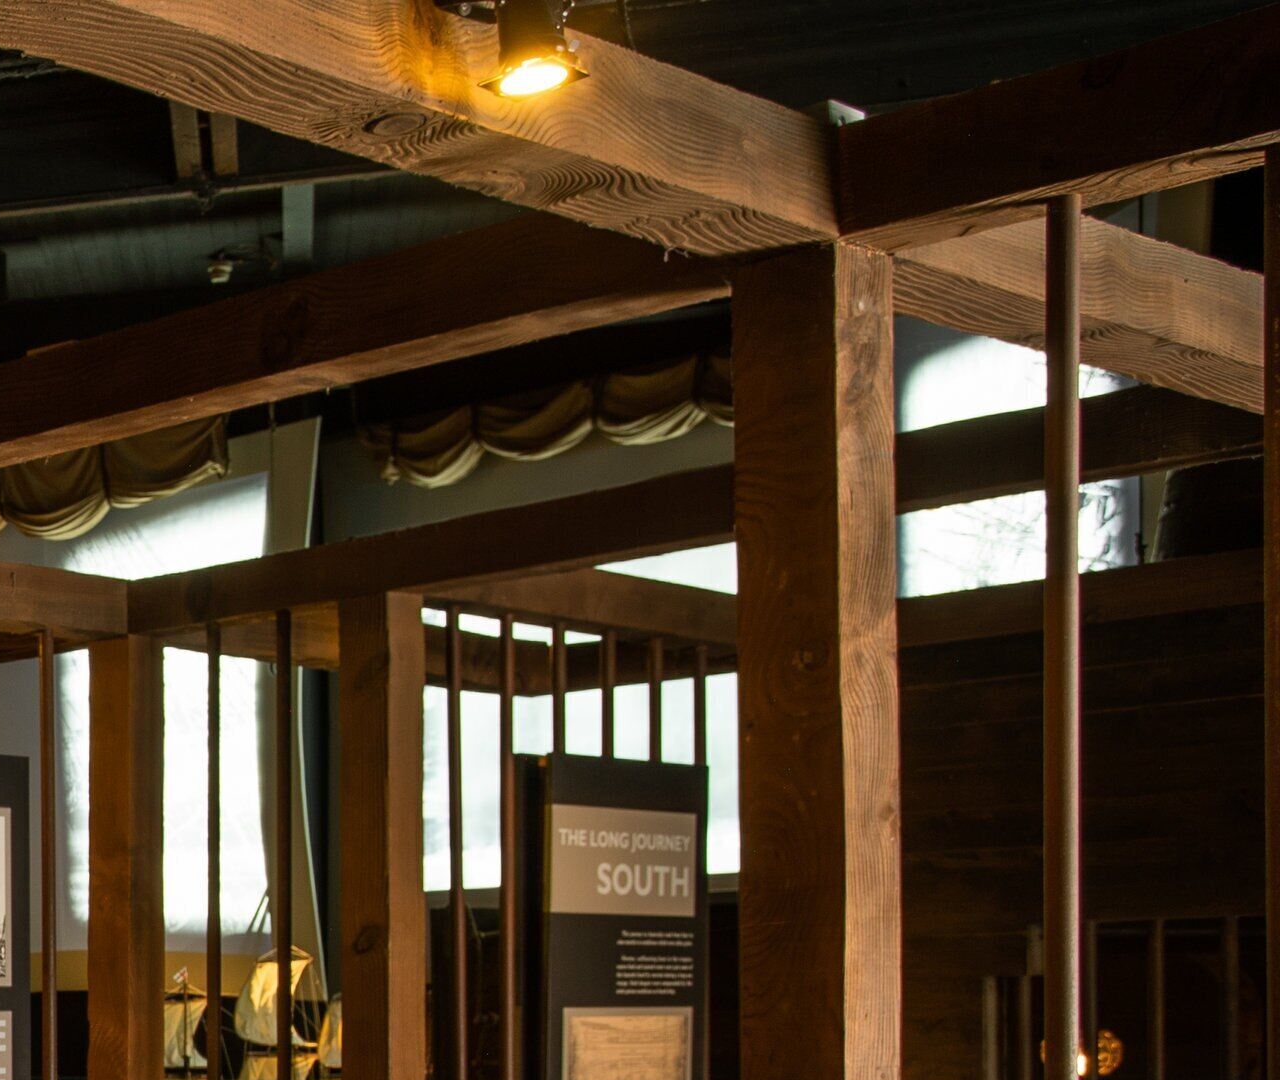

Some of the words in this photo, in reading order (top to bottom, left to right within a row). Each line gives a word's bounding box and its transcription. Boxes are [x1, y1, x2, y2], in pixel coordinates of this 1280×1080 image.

[559, 827, 587, 847] THE
[590, 830, 630, 849] LONG
[631, 832, 690, 853] JOURNEY
[597, 862, 690, 897] SOUTH
